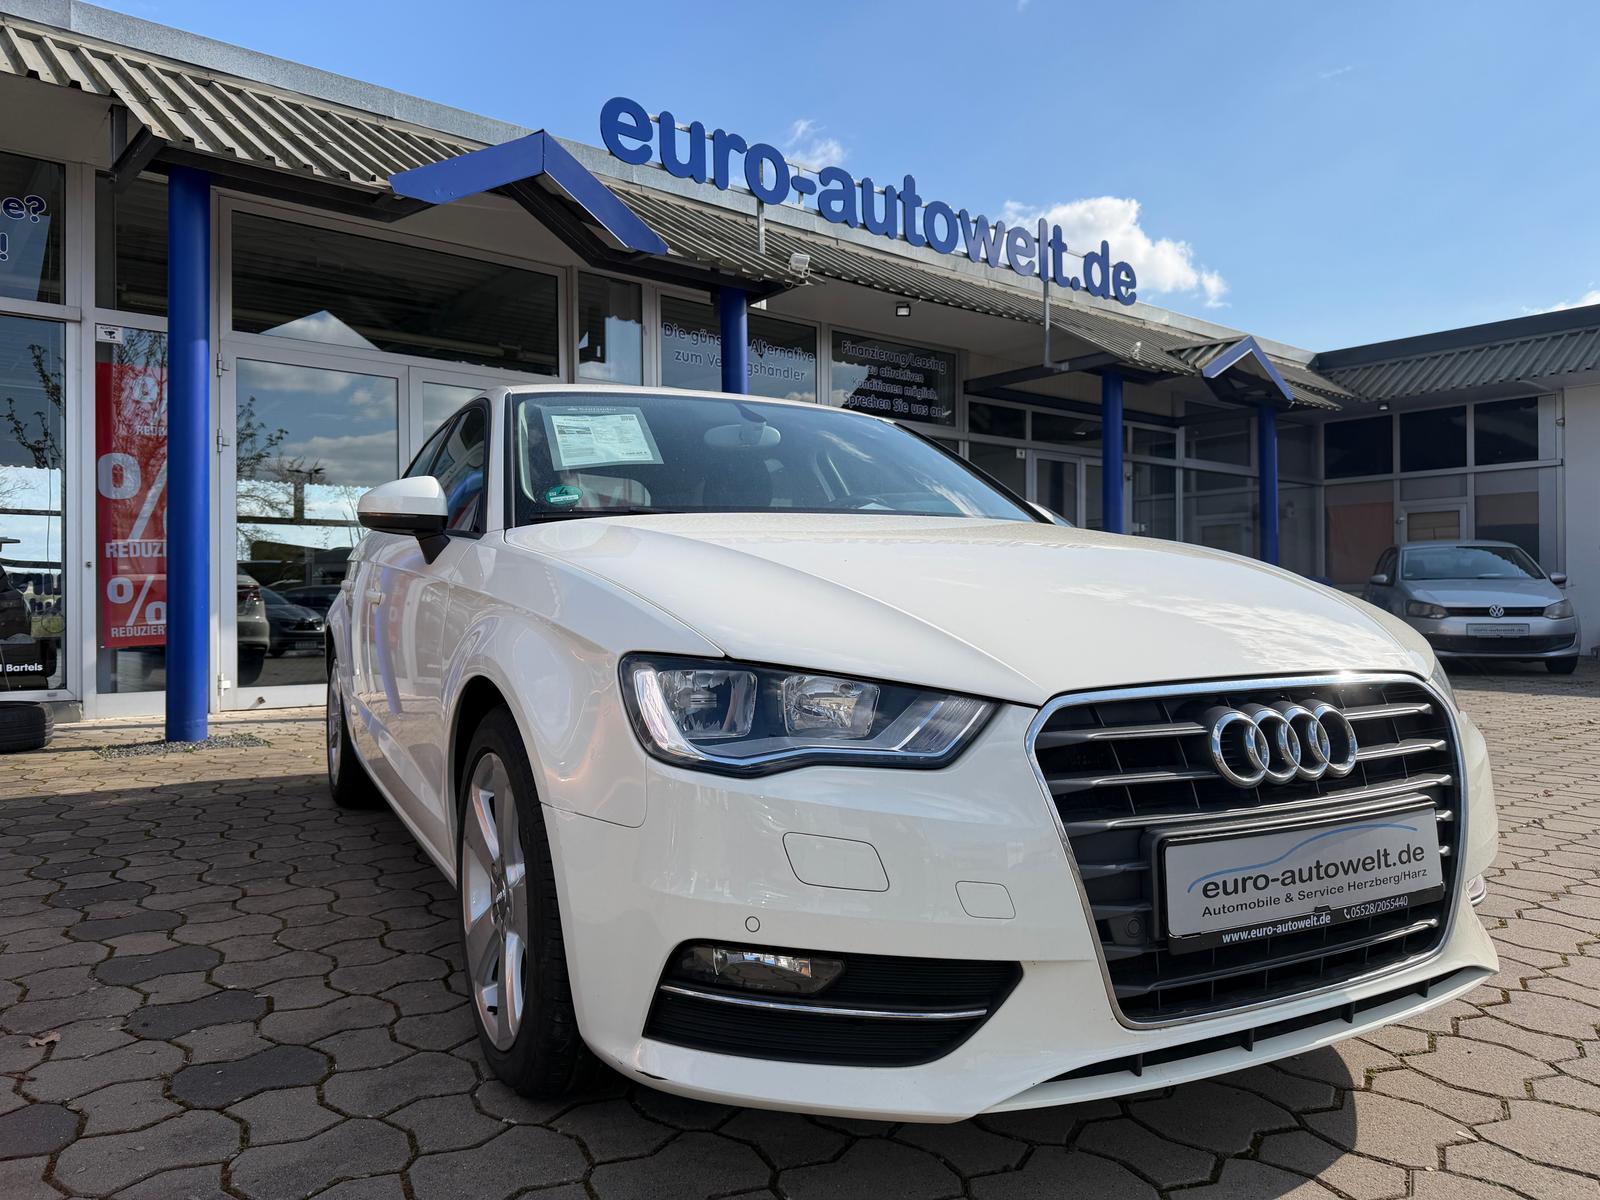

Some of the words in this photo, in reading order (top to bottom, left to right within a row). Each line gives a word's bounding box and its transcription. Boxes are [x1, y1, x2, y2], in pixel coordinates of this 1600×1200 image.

[0, 194, 47, 224] e?
[600, 97, 1137, 306] euro-autowelt.de
[662, 322, 687, 340] Die
[690, 329, 722, 346] güns
[750, 338, 816, 363] Alternative
[674, 350, 702, 365] zum
[841, 340, 947, 375] Finanzierung/Leasing
[879, 367, 925, 384] attraktiven
[844, 392, 891, 411] Sprechen
[892, 398, 909, 414] Sie
[910, 404, 929, 416] uns
[111, 624, 167, 638] REDUZIER
[6, 663, 43, 672] Bartels
[1202, 843, 1425, 899] euro-autowelt.de
[1202, 896, 1281, 918] Automobile
[1285, 892, 1294, 903] &
[1298, 884, 1345, 902] Service
[1348, 868, 1428, 892] Herzberg/Harz
[1222, 912, 1332, 944] www.euro-autowelt.de
[1350, 894, 1409, 919] 05528/2055440
